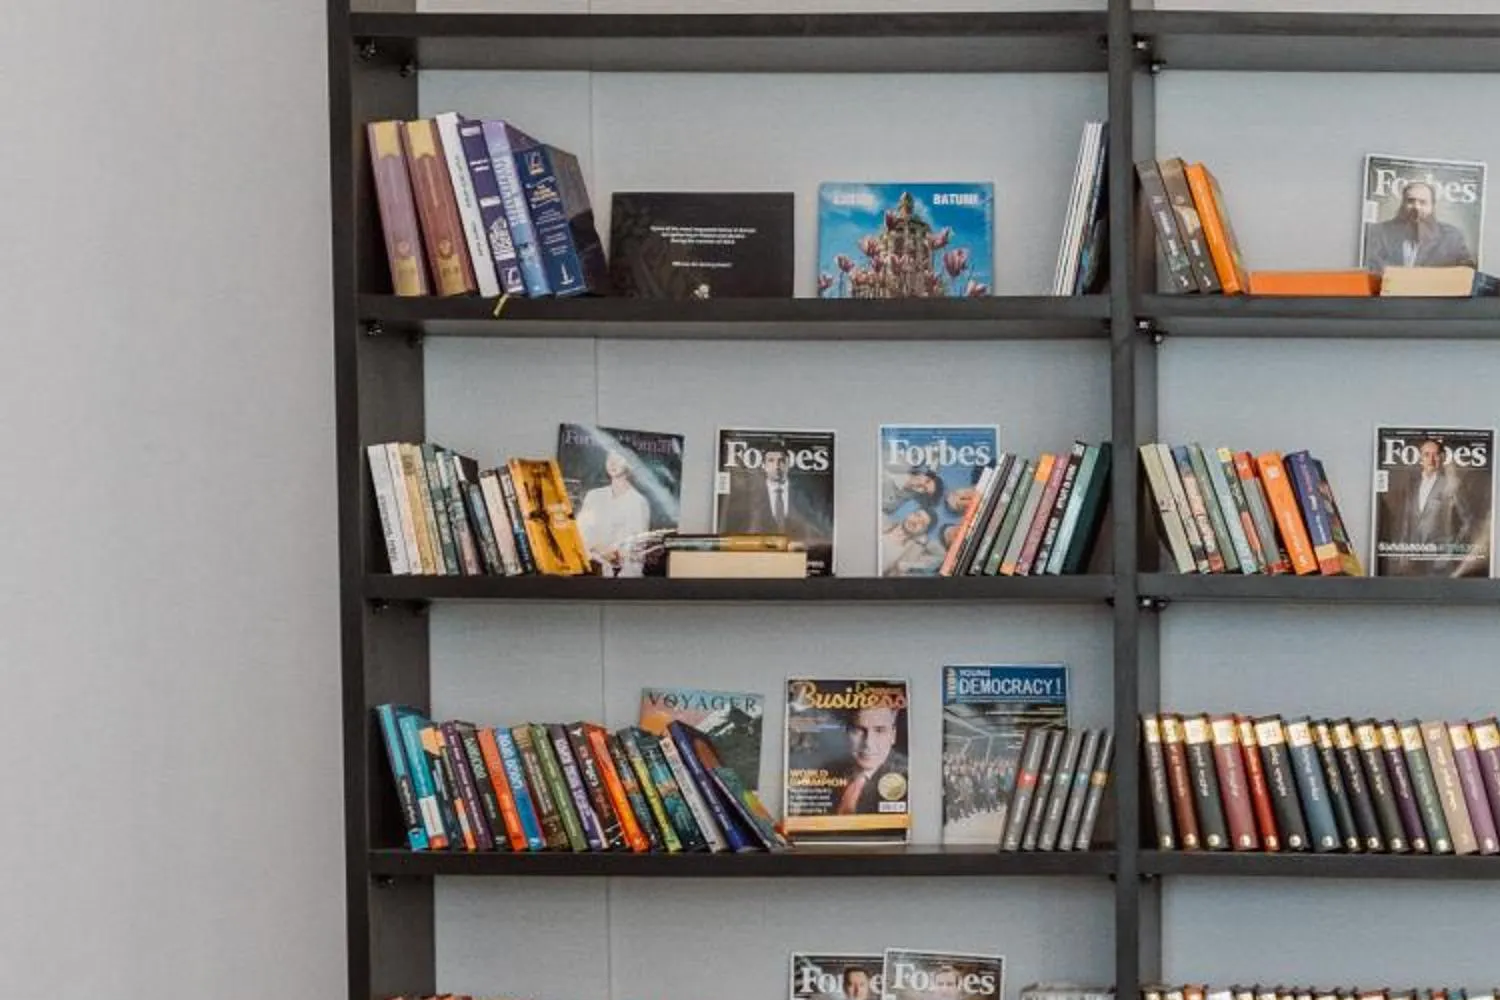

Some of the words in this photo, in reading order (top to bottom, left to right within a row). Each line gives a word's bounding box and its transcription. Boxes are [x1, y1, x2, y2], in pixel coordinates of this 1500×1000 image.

[1373, 168, 1477, 204] Fobes
[723, 440, 829, 471] Foes
[888, 439, 991, 467] Forbes
[1382, 439, 1487, 467] Foes
[648, 691, 757, 711] VOYAGER
[791, 681, 907, 710] Business
[799, 967, 883, 995] Foe
[891, 962, 995, 995] Foes
